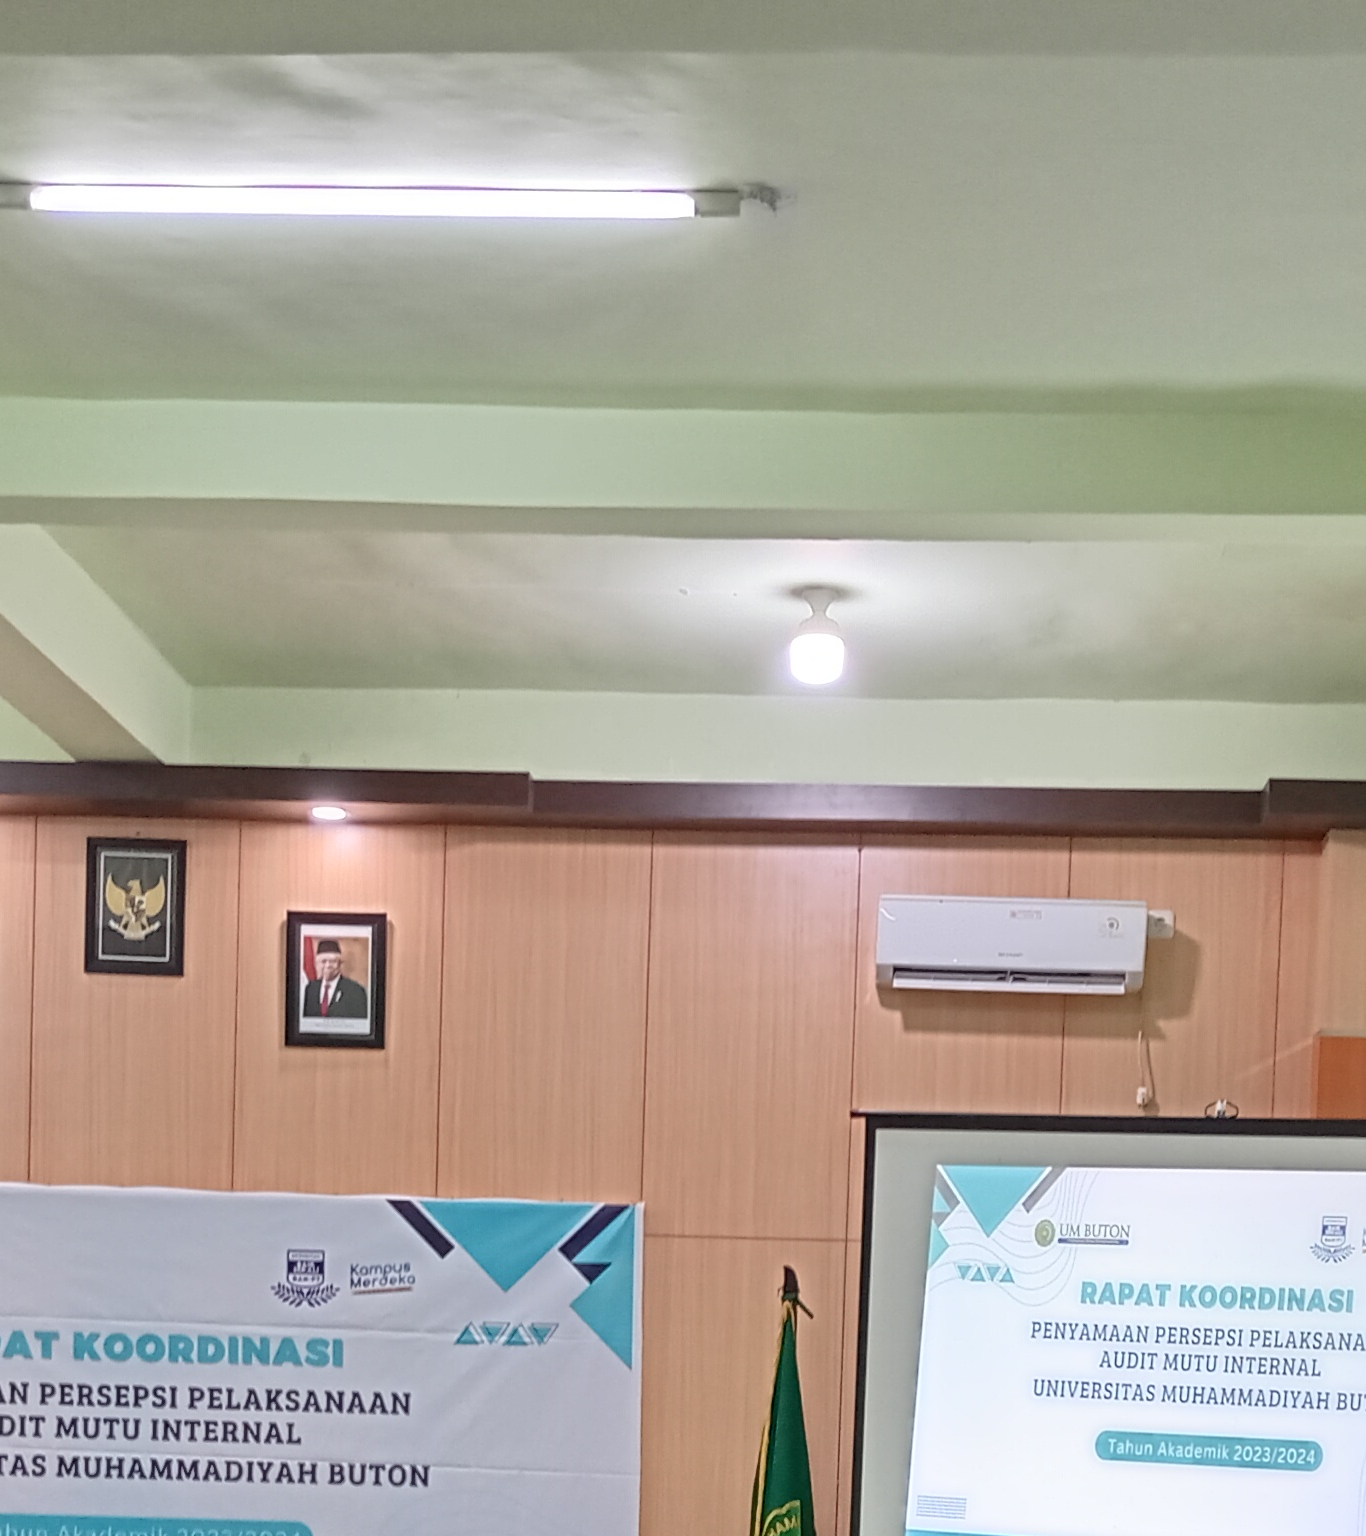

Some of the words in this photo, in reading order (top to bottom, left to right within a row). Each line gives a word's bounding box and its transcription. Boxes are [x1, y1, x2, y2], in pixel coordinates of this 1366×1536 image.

[1059, 1223, 1081, 1237] UM
[1084, 1223, 1131, 1238] BUTON
[350, 1262, 411, 1279] Kampus
[350, 1274, 416, 1289] Merdeka
[1079, 1281, 1172, 1307] RAPAT
[1178, 1284, 1354, 1313] KOORDINASI
[1030, 1321, 1150, 1344] PENYAMAAN
[1154, 1326, 1244, 1347] PERSEPSI
[73, 1331, 344, 1368] KOORDINASI
[1098, 1350, 1158, 1371] AUDIT
[1162, 1353, 1218, 1373] MUTU
[1223, 1355, 1322, 1377] INTERNAL
[39, 1382, 178, 1410] PERSEPSI
[188, 1386, 412, 1416] PELAKSANAAN
[1033, 1378, 1156, 1402] UNIVERSITAS
[1161, 1384, 1331, 1410] MUHAMMADIYAH
[54, 1416, 142, 1441] MUTU
[150, 1419, 302, 1445] INTERNAL
[1108, 1438, 1153, 1457] Tahun
[1157, 1441, 1230, 1461] Akademik
[1233, 1445, 1316, 1465] 2023/2024
[56, 1455, 318, 1485] MUHAMMADIYAH
[328, 1463, 431, 1488] BUTON
